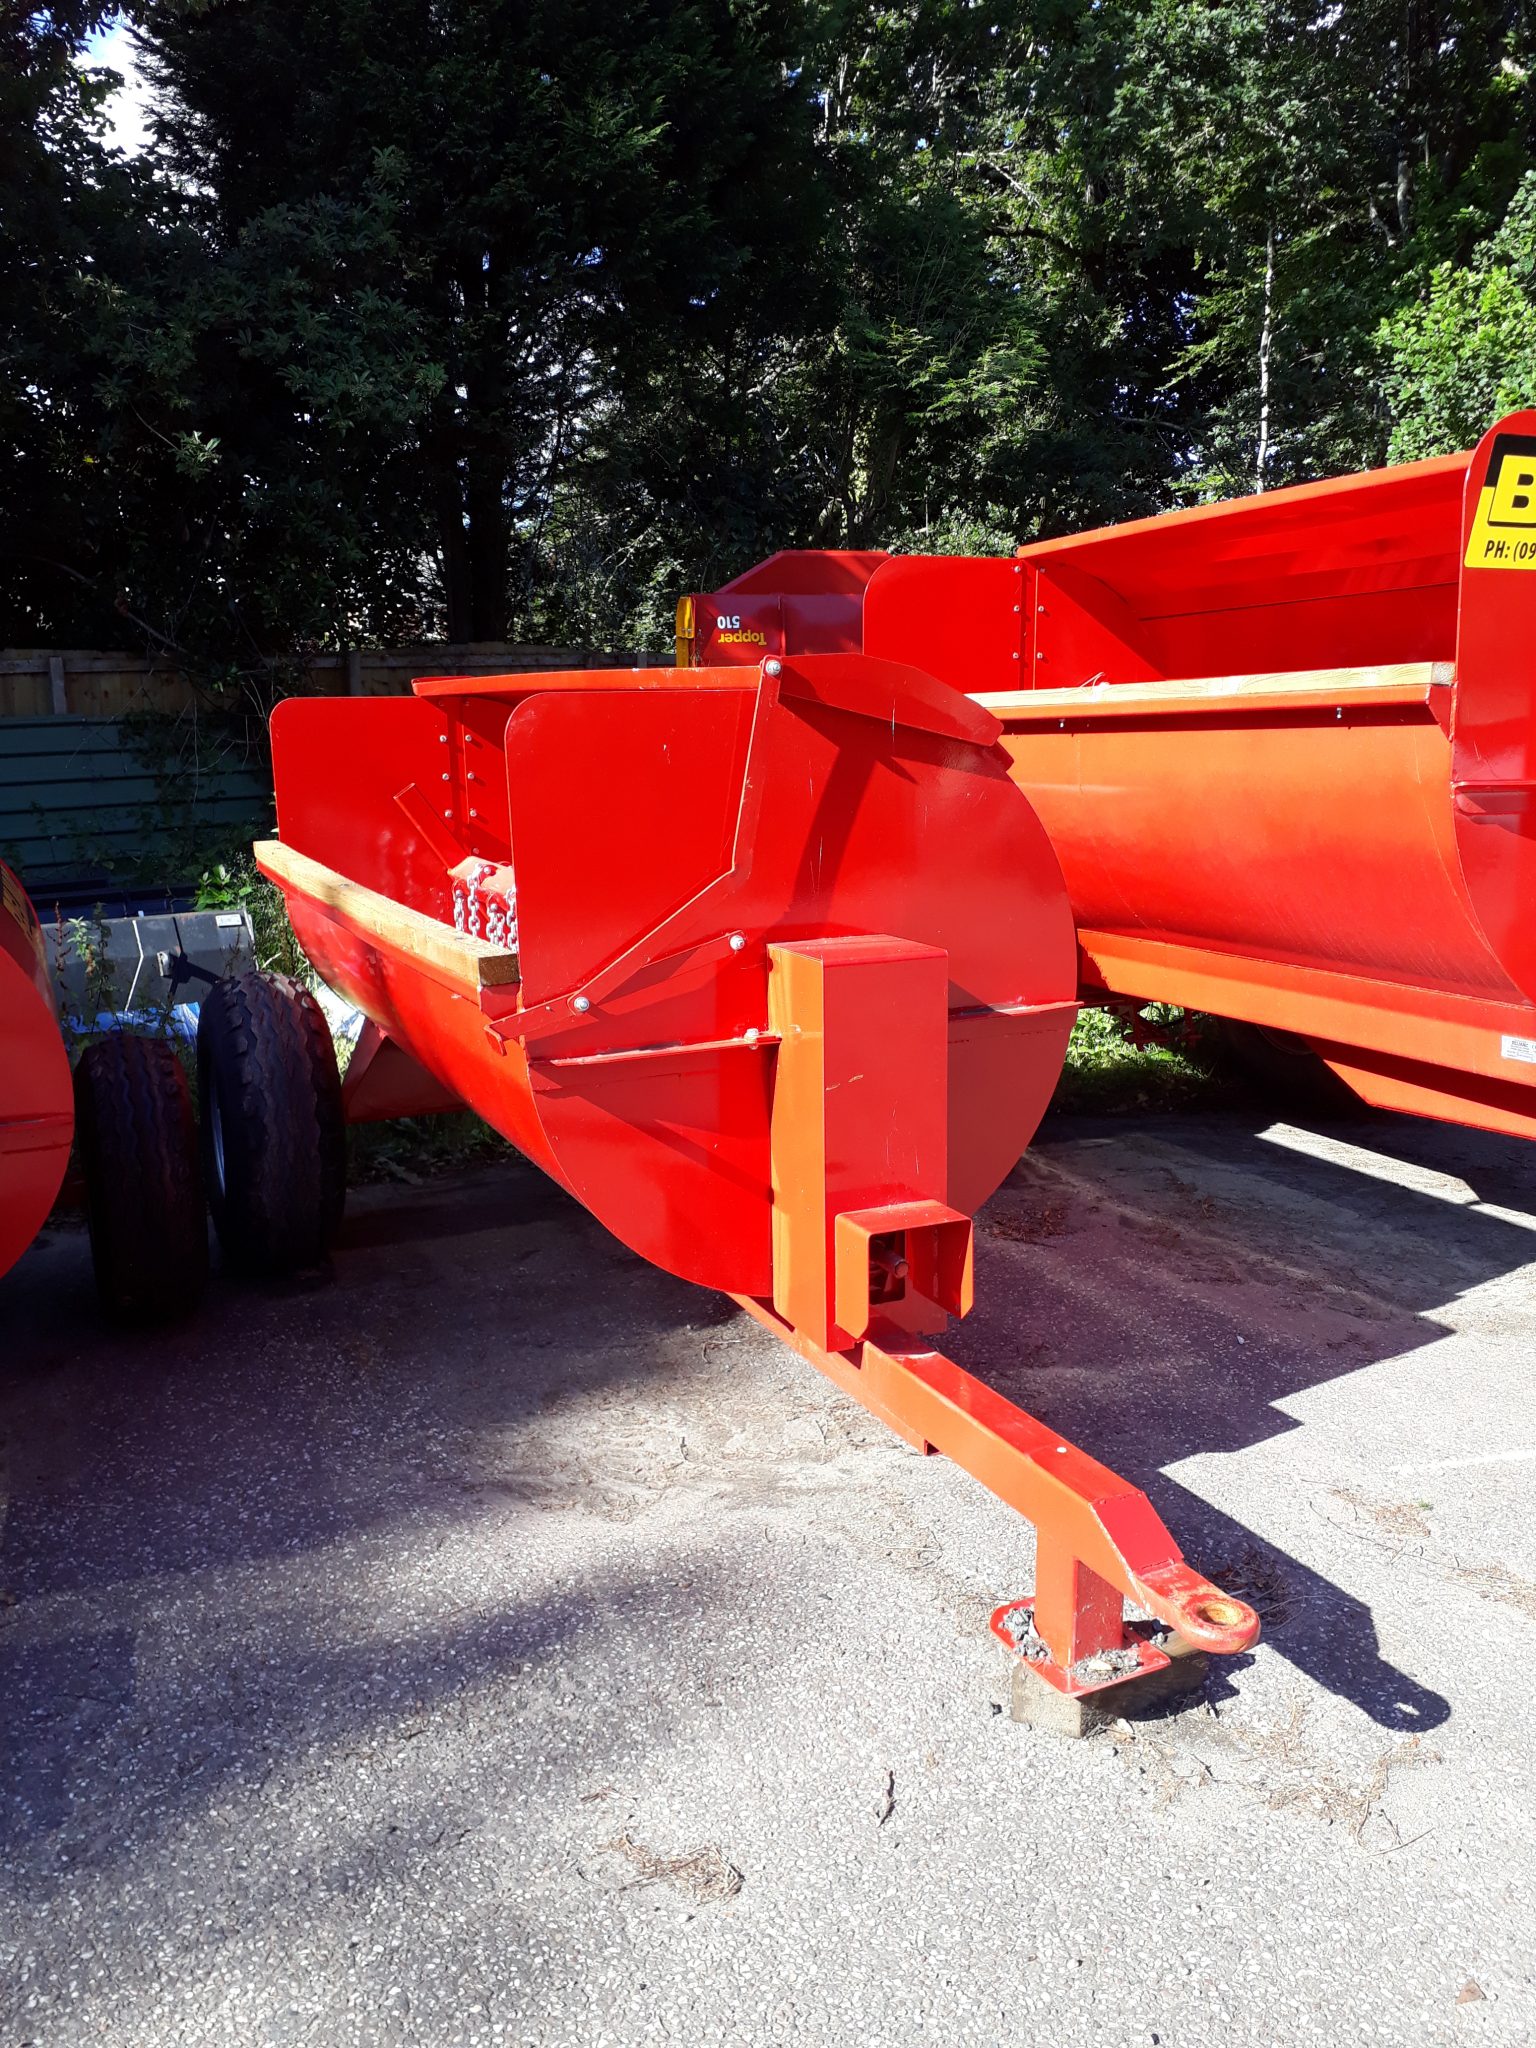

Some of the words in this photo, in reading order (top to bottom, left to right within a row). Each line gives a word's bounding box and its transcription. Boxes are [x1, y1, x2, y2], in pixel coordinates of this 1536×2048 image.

[1484, 540, 1510, 559] PH:
[717, 615, 740, 629] 510
[718, 630, 767, 645] Topper
